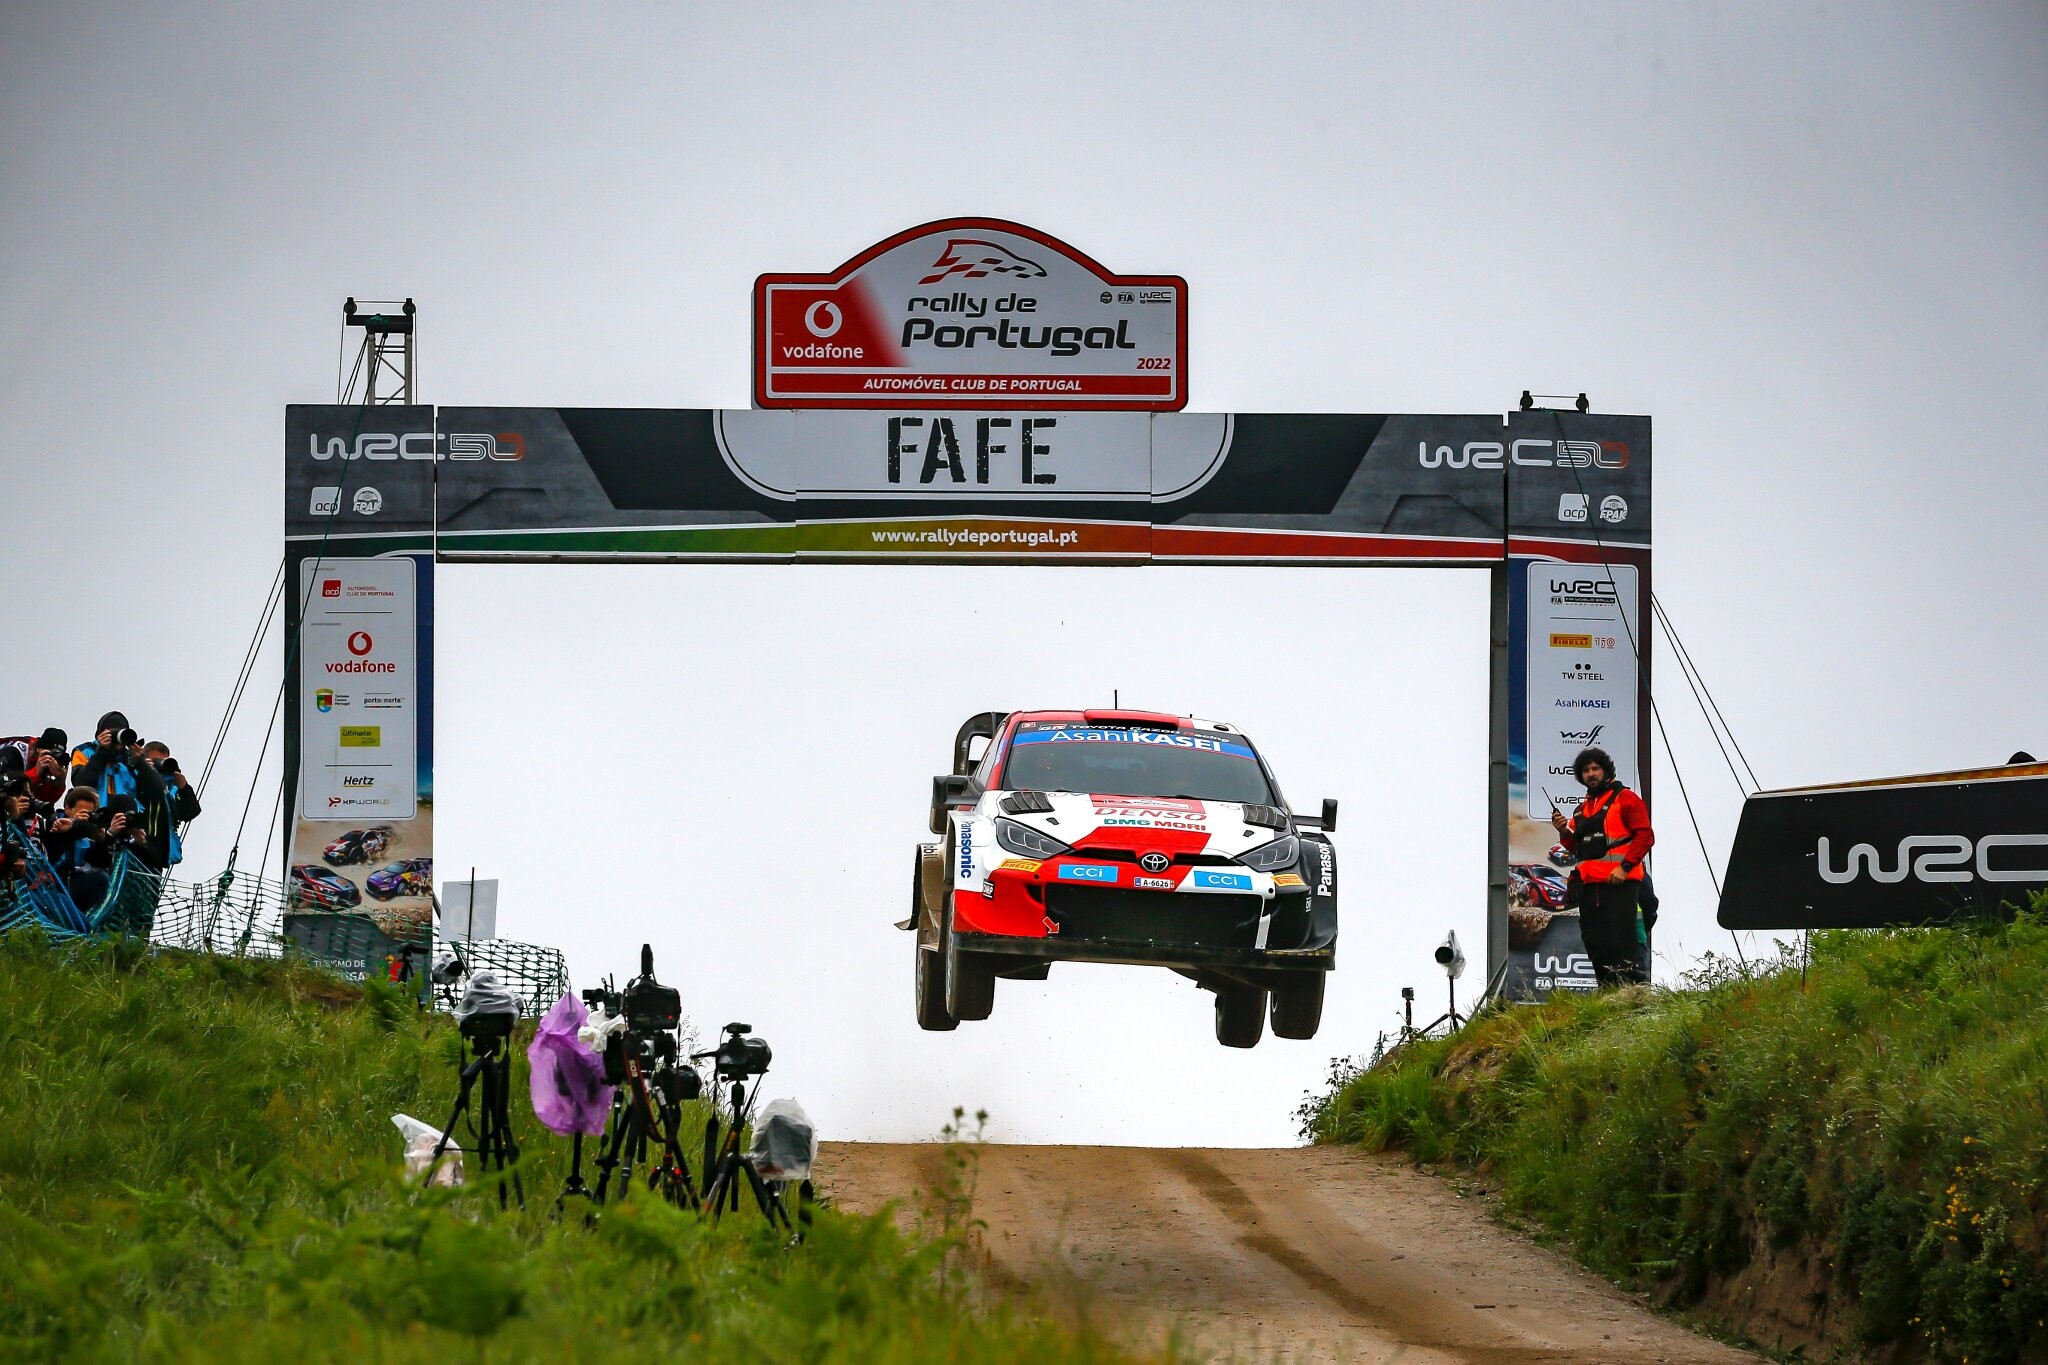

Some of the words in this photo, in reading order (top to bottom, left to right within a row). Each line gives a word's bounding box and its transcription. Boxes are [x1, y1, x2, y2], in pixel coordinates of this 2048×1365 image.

[1139, 291, 1172, 299] WRC
[907, 292, 989, 318] rally
[994, 292, 1038, 312] de
[901, 318, 1136, 356] Portugal
[782, 342, 864, 359] vodafone
[1136, 356, 1171, 370] 2022
[863, 376, 949, 391] AUTOMÓVEL
[951, 378, 987, 390] CLUB
[989, 379, 1008, 390] DE
[1010, 379, 1082, 391] PORTUGAL
[887, 416, 1057, 485] FAFE
[315, 502, 338, 513] acp
[1563, 508, 1586, 519] acp
[871, 528, 1078, 547] www.rallydeportugal.pt
[1550, 579, 1616, 595] WRC
[325, 660, 396, 673] vodafone
[1561, 672, 1576, 680] TW
[1577, 672, 1605, 681] STEEL
[1555, 698, 1610, 709] AsahiKASEI
[1559, 725, 1606, 747] wolf
[1549, 765, 1576, 775] WR
[343, 775, 375, 786] Hertz
[1094, 807, 1208, 821] DENSO
[1103, 818, 1152, 826] DMG
[1154, 820, 1207, 831] MORI
[960, 820, 976, 879] Panasonic
[1002, 859, 1037, 871] PIRELLI
[1817, 834, 2048, 884] WRC
[1142, 879, 1170, 888] A-6626
[353, 959, 366, 968] DE
[1534, 952, 1596, 975] WR
[1535, 978, 1552, 988] FIA
[628, 1059, 639, 1078] EOS
